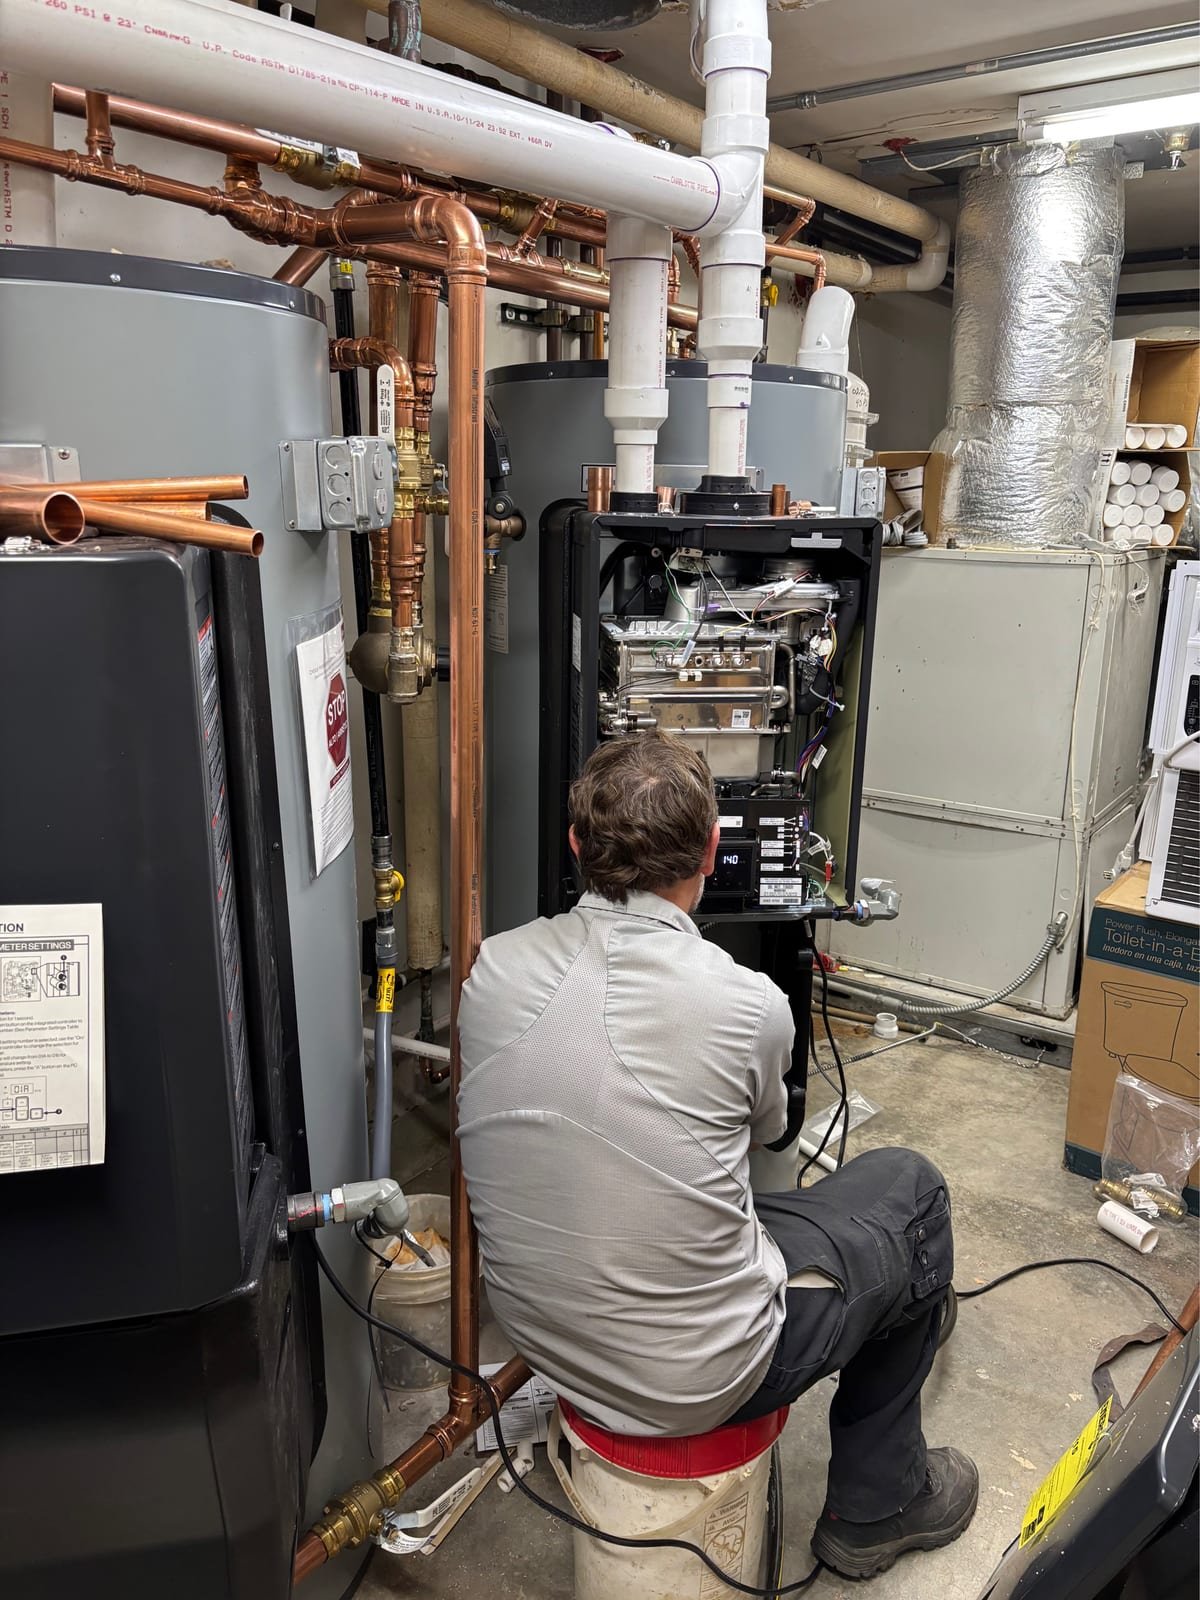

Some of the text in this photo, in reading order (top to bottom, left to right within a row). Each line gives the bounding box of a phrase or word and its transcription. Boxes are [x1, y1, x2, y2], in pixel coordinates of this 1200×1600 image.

[391, 96, 410, 108] MADE
[416, 102, 424, 112] IN
[328, 690, 345, 726] STOP
[724, 855, 738, 864] 140
[1105, 918, 1134, 932] Power
[1136, 925, 1163, 939] Flush,
[28, 941, 72, 950] SETTINGS
[1102, 944, 1133, 957] Inodoro
[1164, 958, 1183, 969] caja,
